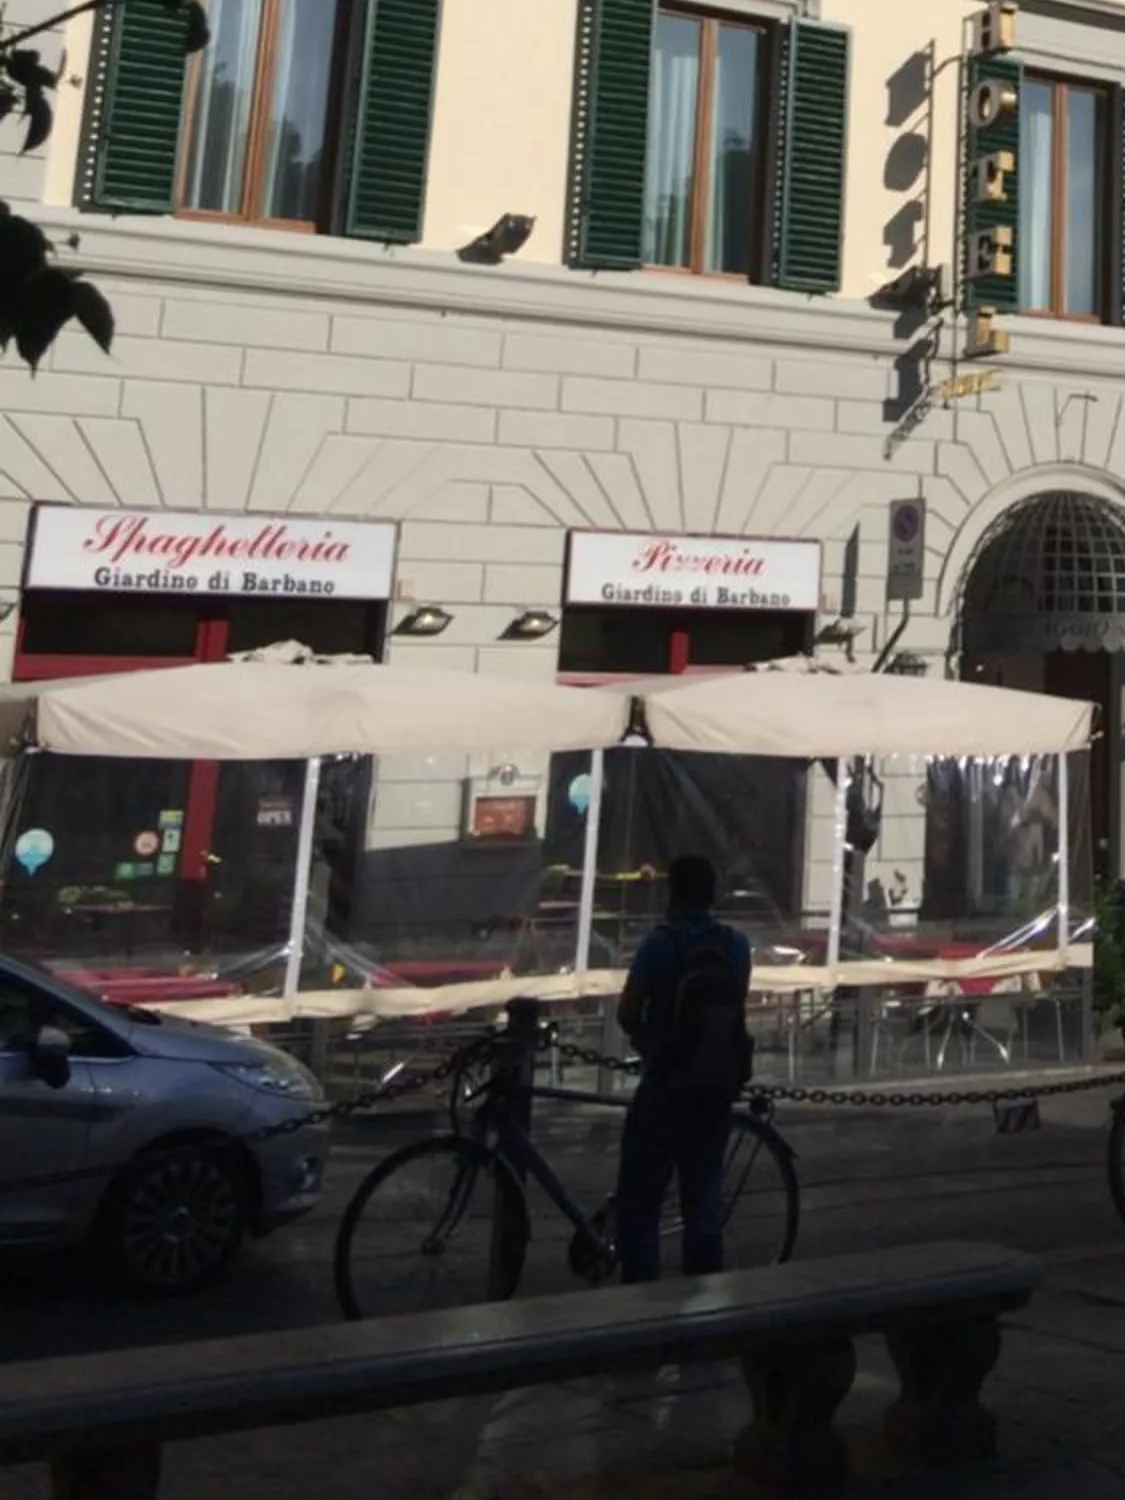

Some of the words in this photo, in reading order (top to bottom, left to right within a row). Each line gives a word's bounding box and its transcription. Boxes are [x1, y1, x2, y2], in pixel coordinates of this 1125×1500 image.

[963, 2, 1018, 358] HOTEL
[83, 514, 350, 568] Spaghetteria
[631, 539, 765, 576] Pizzeria
[93, 567, 198, 591] Giardino
[208, 570, 229, 591] di
[241, 572, 336, 596] Barbano
[601, 583, 683, 603] Giardino
[690, 583, 708, 604] di
[717, 586, 791, 607] Barbano
